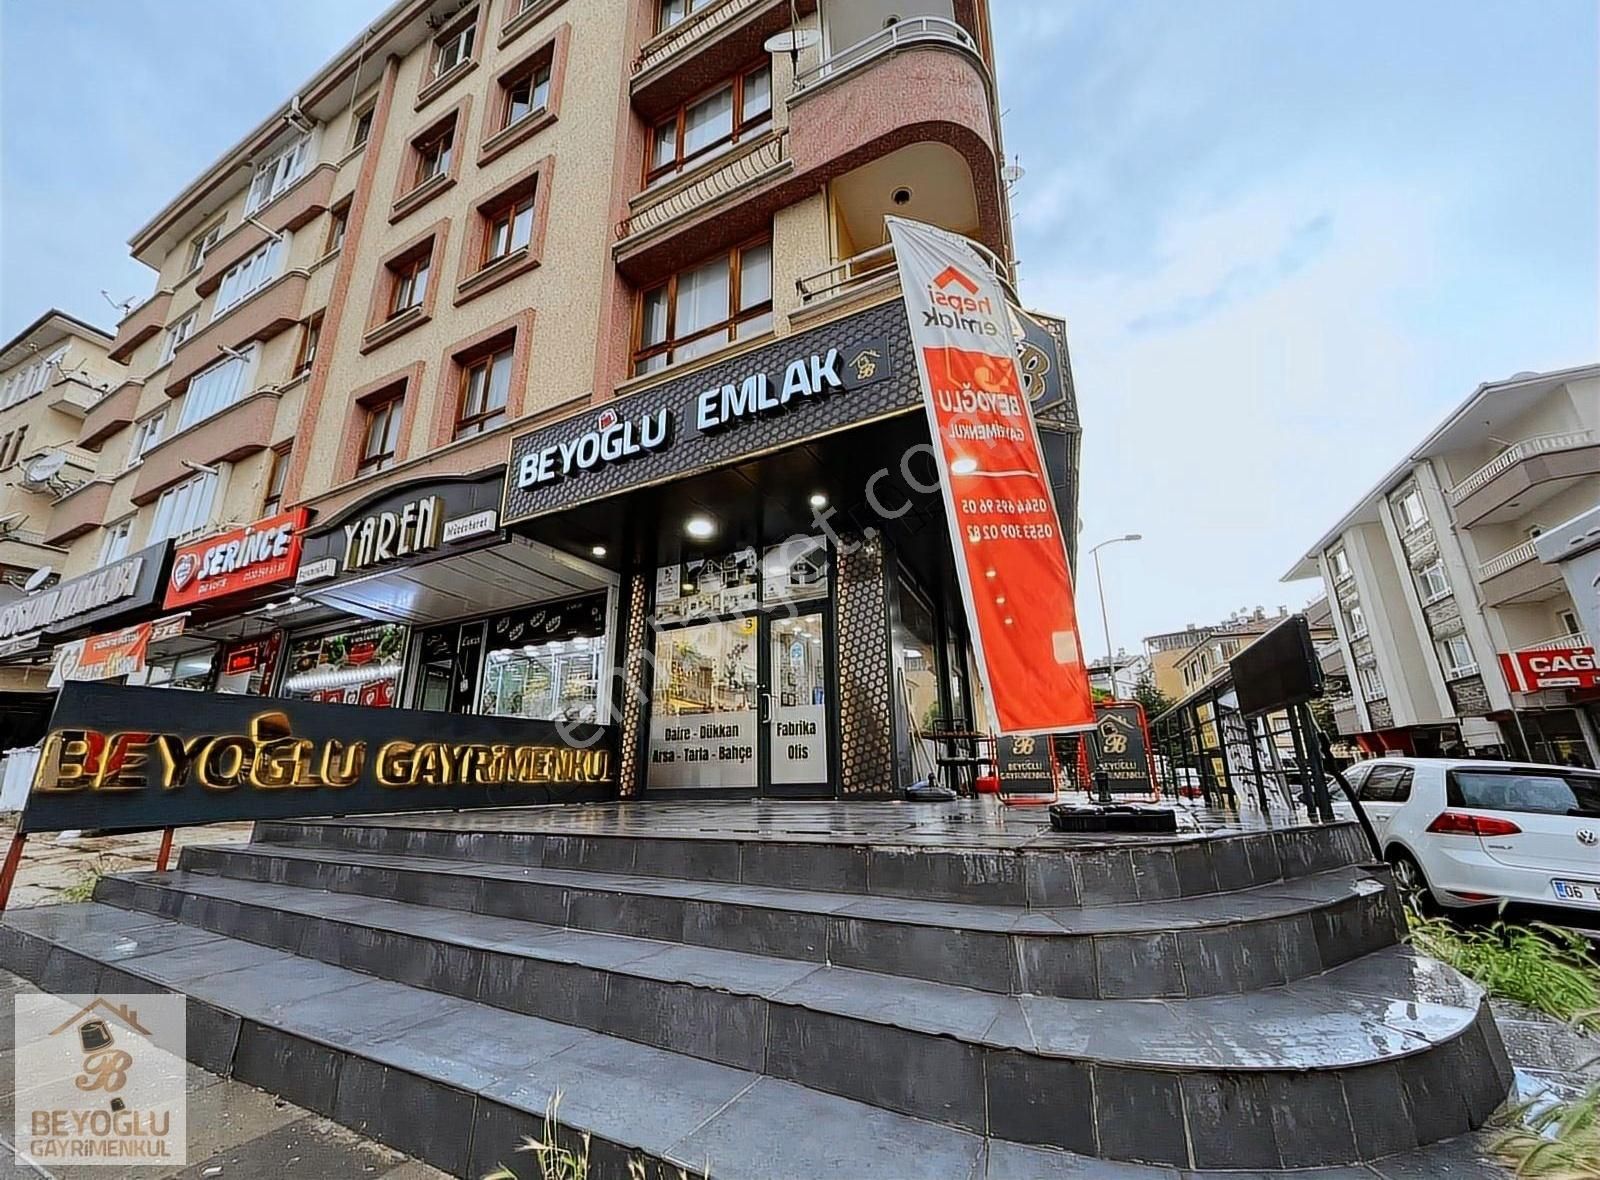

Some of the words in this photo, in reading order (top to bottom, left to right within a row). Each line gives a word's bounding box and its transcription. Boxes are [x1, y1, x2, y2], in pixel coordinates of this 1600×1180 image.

[697, 347, 842, 431] EMLAK
[342, 495, 437, 572] YAREN
[197, 523, 293, 580] SERİNCE
[665, 726, 690, 741] Daire
[700, 723, 739, 740] Dükkan
[777, 720, 817, 738] Fabrika
[652, 748, 675, 763] Arsa
[683, 746, 709, 762] Tarla
[718, 744, 752, 764] Bahçe
[788, 745, 809, 760] Ofis
[1564, 885, 1583, 899] 06
